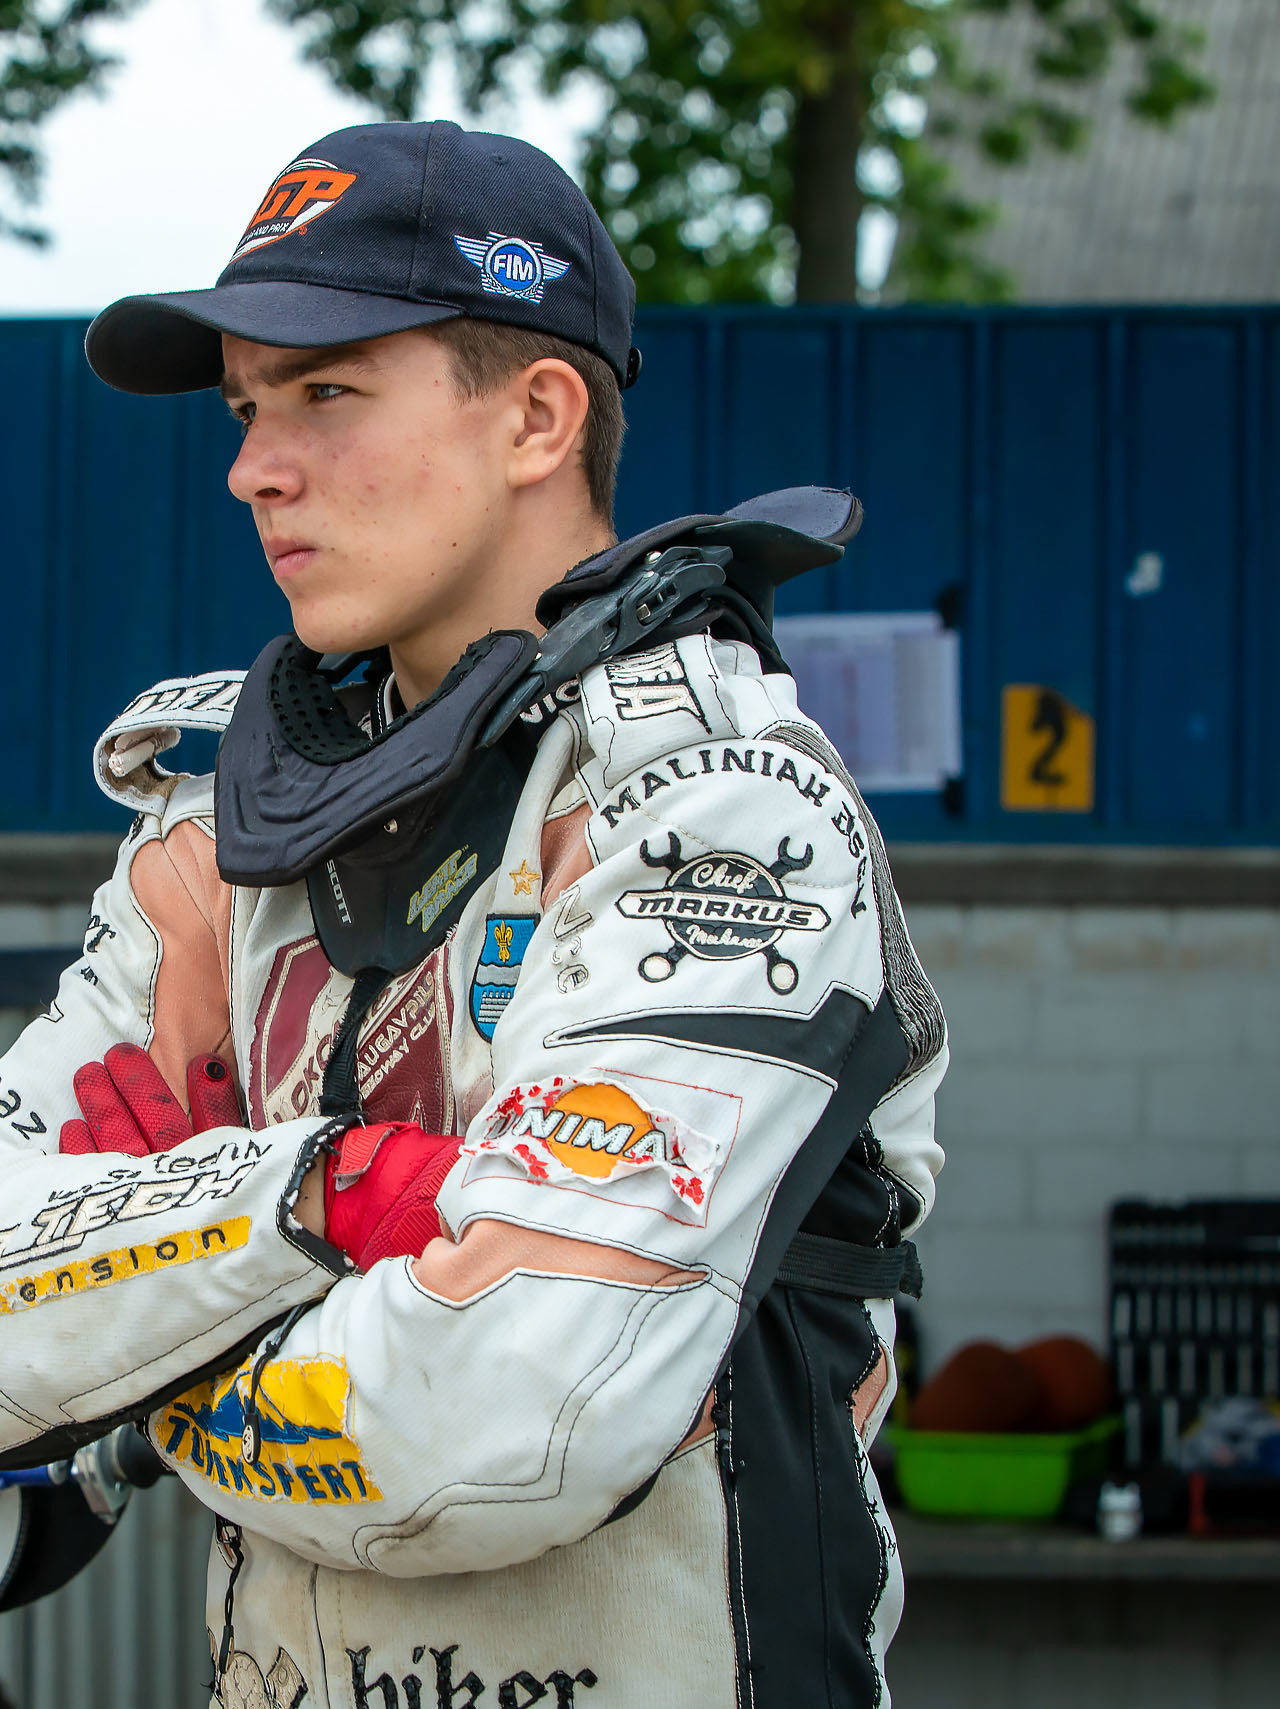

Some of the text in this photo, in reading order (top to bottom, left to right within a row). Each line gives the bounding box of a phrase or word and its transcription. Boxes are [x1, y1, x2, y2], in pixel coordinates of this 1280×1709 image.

[493, 254, 534, 282] FIM
[1030, 688, 1067, 786] 2
[326, 858, 352, 925] SCOTT
[637, 897, 813, 926] MARKUS
[354, 970, 435, 1082] AUGAVPILS
